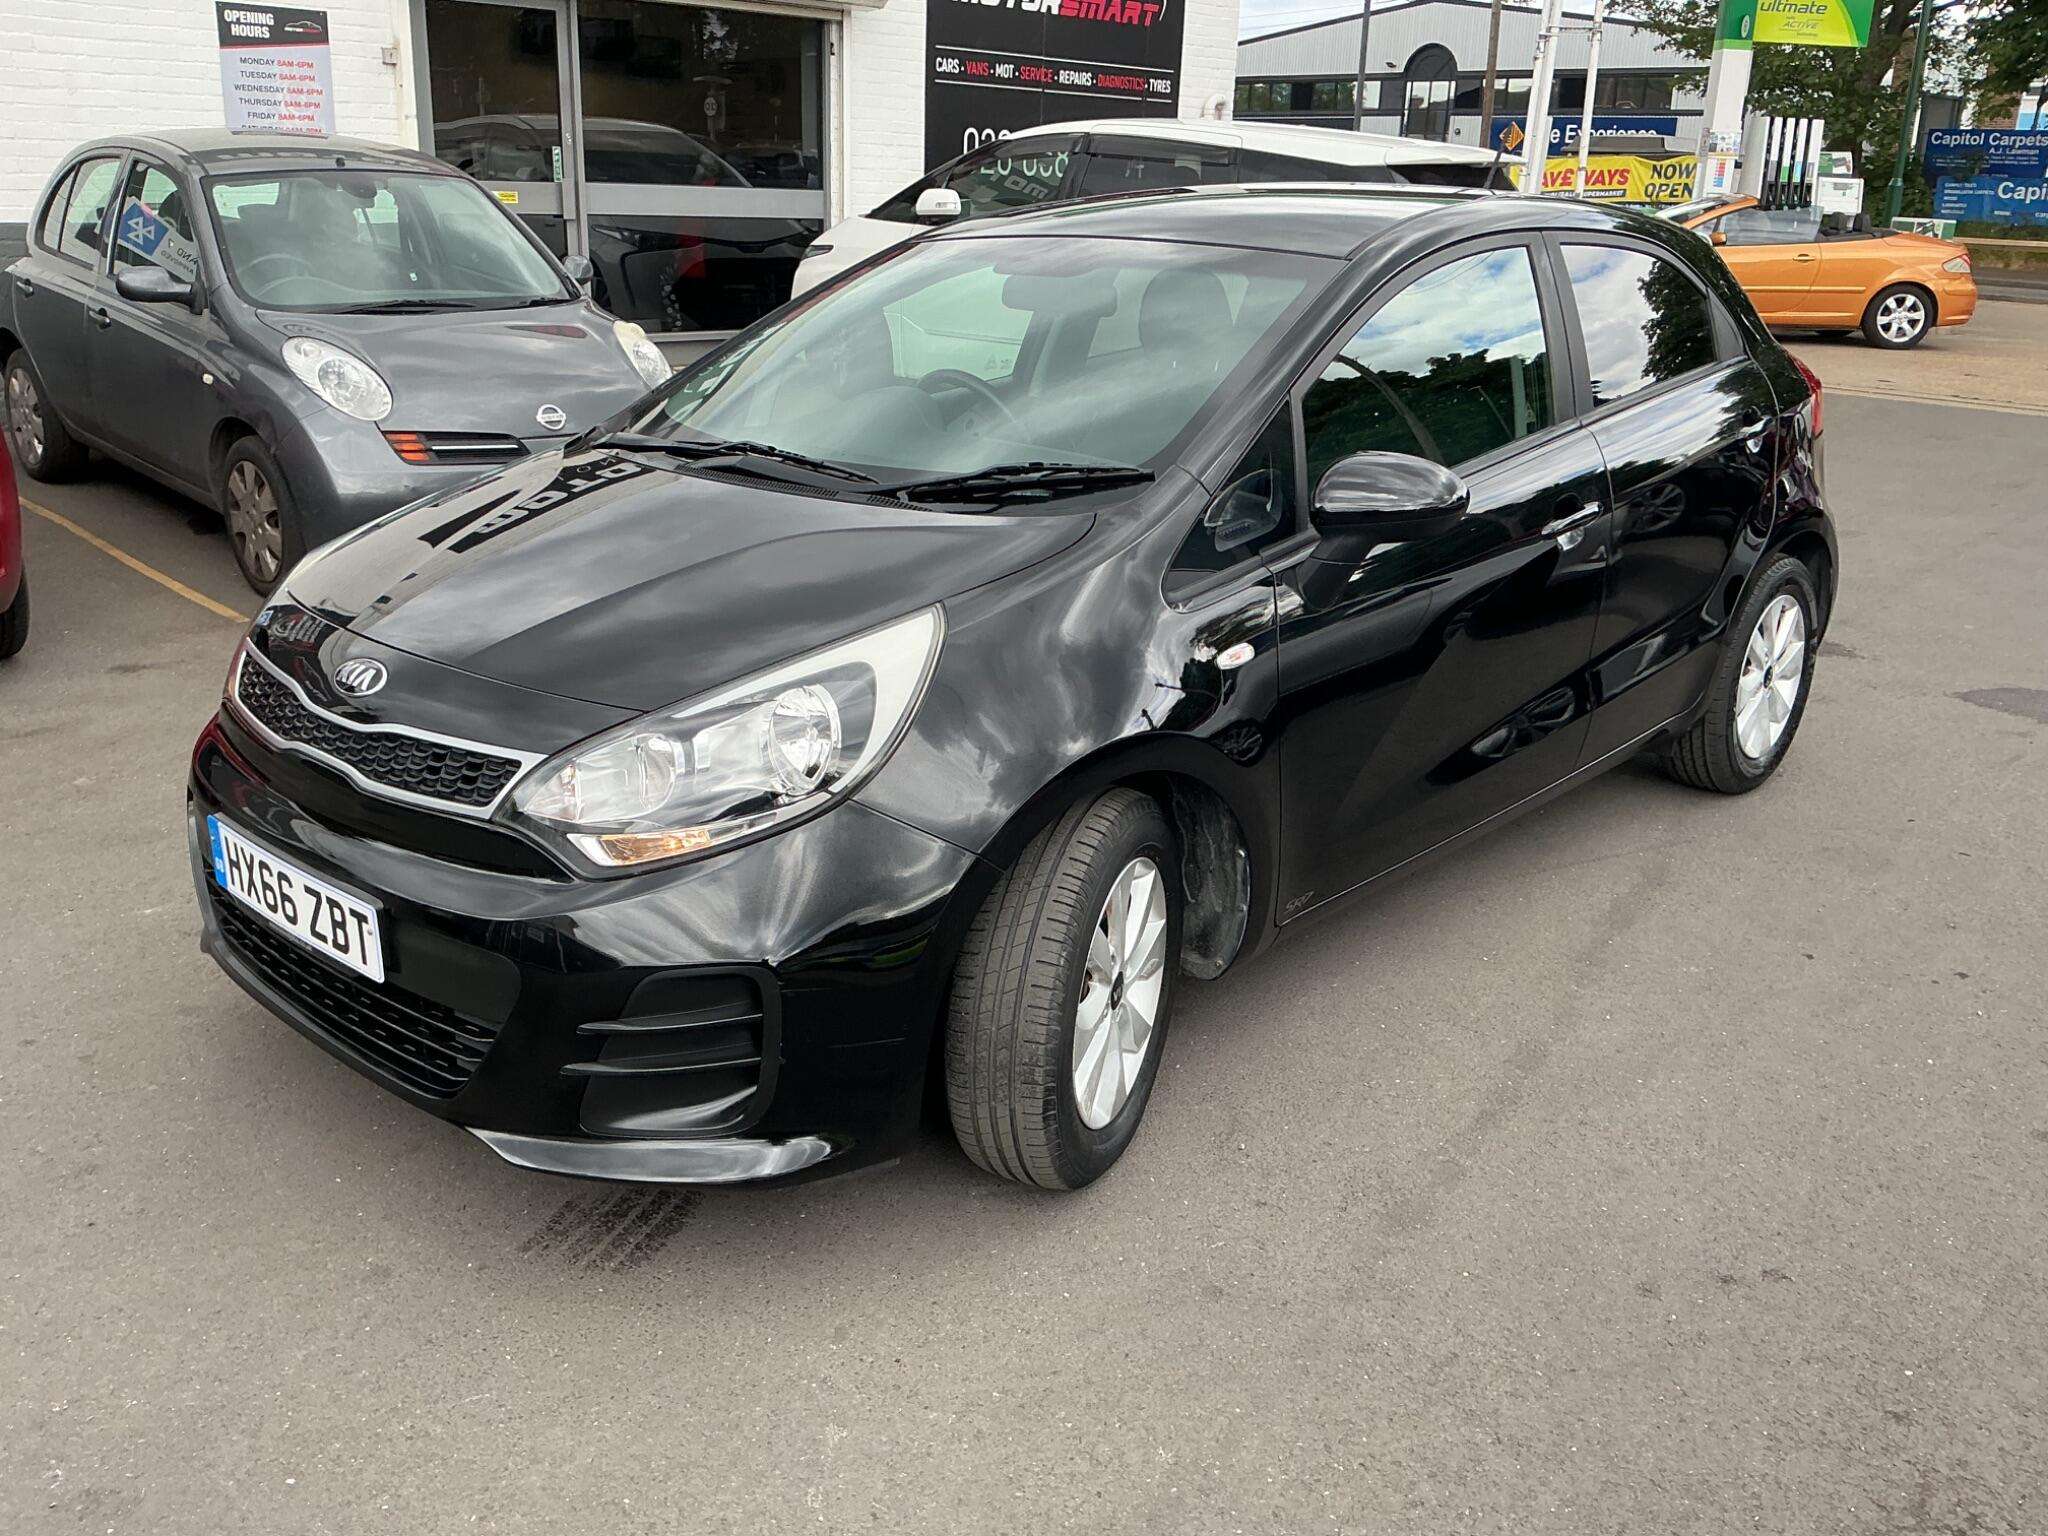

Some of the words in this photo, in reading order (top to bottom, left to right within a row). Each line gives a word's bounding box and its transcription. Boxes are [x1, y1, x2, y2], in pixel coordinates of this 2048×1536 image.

[224, 10, 274, 25] OPENING
[231, 24, 270, 38] HOURS
[240, 57, 275, 66] MONDAY
[241, 70, 277, 79] TUESDAY
[936, 57, 960, 75] CARS
[966, 60, 989, 76] VANS
[995, 63, 1014, 79] MOT
[1020, 66, 1053, 83] SERVICE
[1059, 69, 1092, 86] REPAIRS
[1098, 74, 1144, 91] DIAGNOSTICS
[1149, 77, 1171, 93] TYRES
[234, 84, 285, 94] WEDNESDAY
[239, 97, 282, 107] THURSDAY
[248, 111, 276, 120] FRIDAY
[1931, 132, 1985, 147] Capitol
[1989, 132, 2048, 148] Carpets
[1650, 163, 1697, 180] NOW
[1583, 189, 1625, 197] UPERMARKET
[1645, 182, 1694, 199] OPEN
[1998, 182, 2048, 204] Capi
[335, 661, 378, 691] KIA
[223, 835, 299, 926] HX66
[303, 884, 370, 966] ZBT
